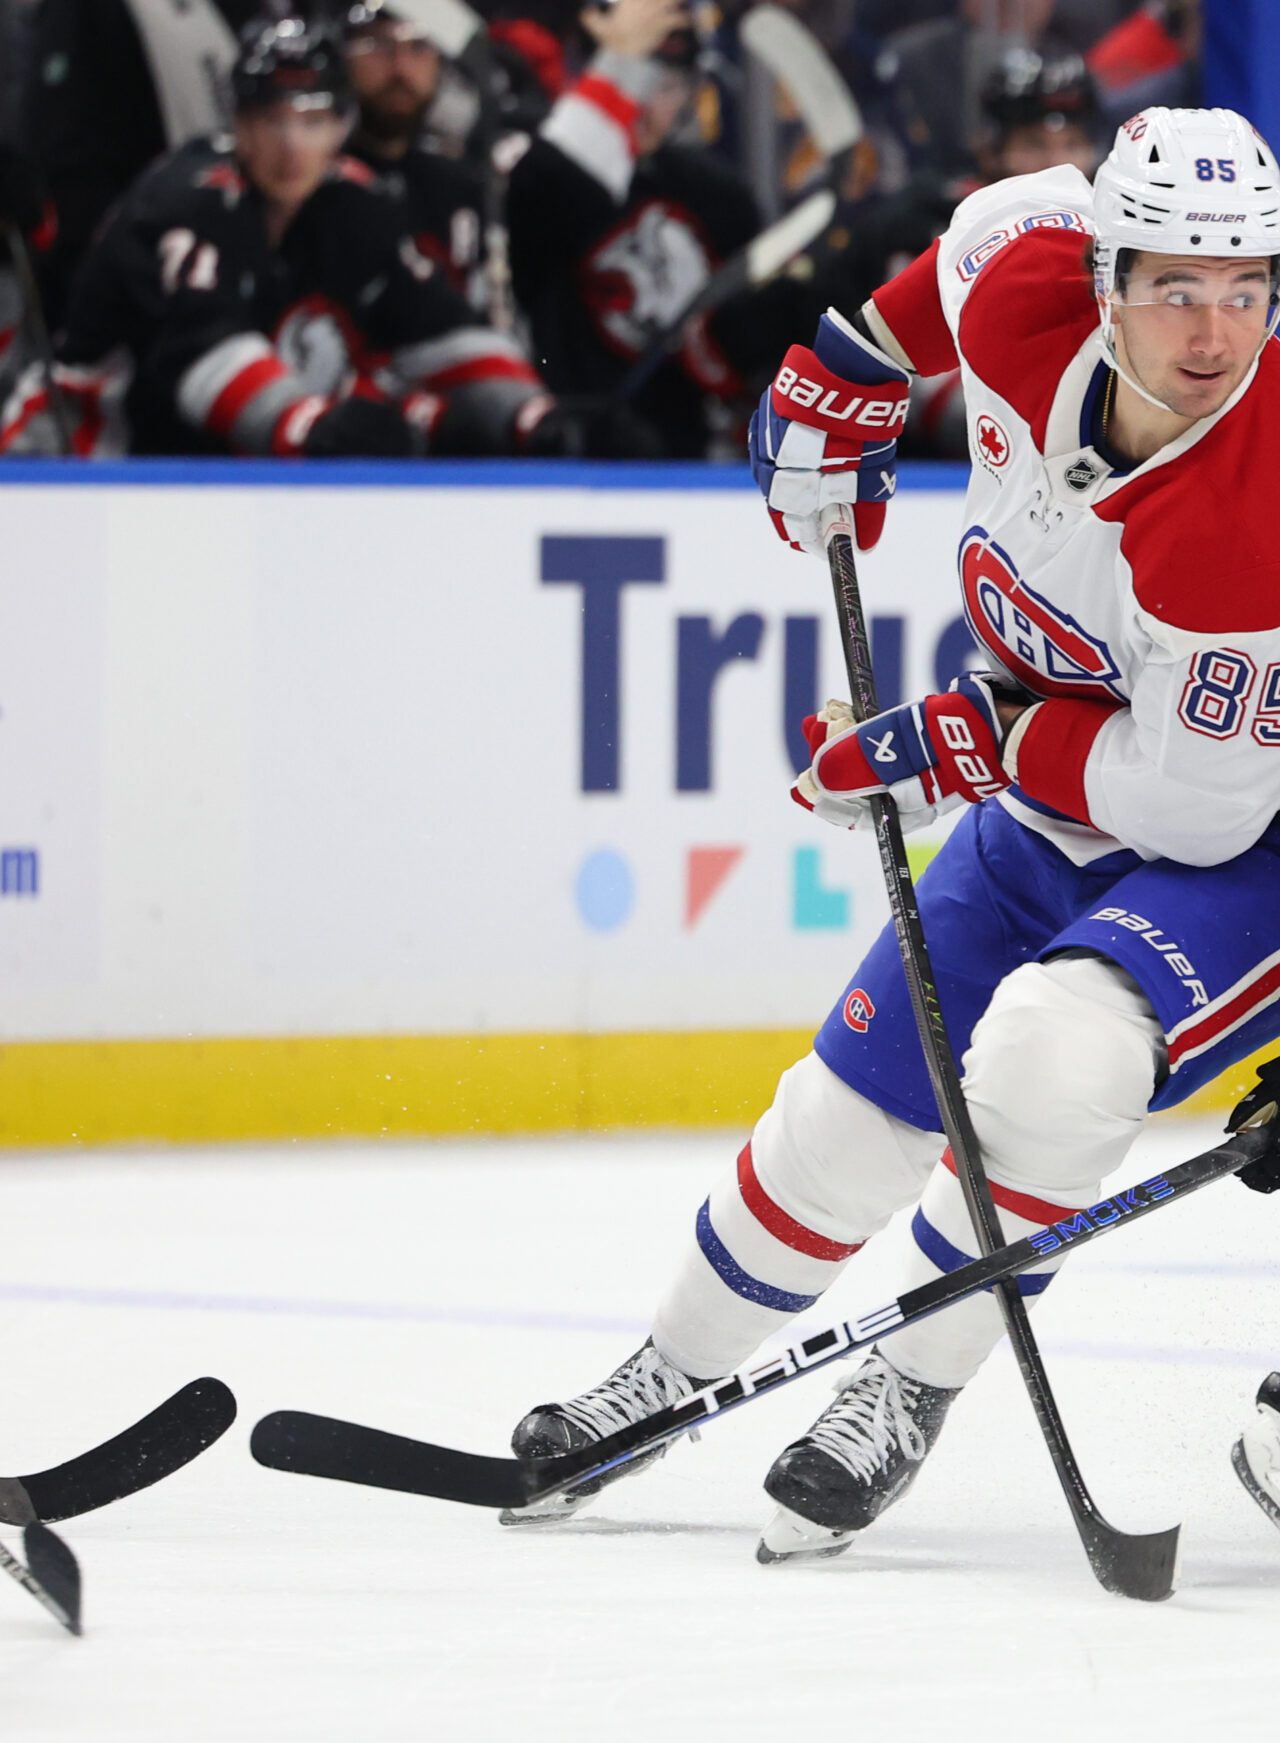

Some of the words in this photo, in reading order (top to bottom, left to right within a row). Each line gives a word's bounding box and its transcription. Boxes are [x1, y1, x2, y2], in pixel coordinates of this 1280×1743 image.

[1195, 158, 1236, 182] 85
[1185, 211, 1248, 224] BAUER
[1068, 470, 1093, 483] NHL
[1088, 907, 1209, 1007] BAUER
[1027, 1174, 1175, 1255] SMOKE
[673, 1302, 905, 1415] TRUE
